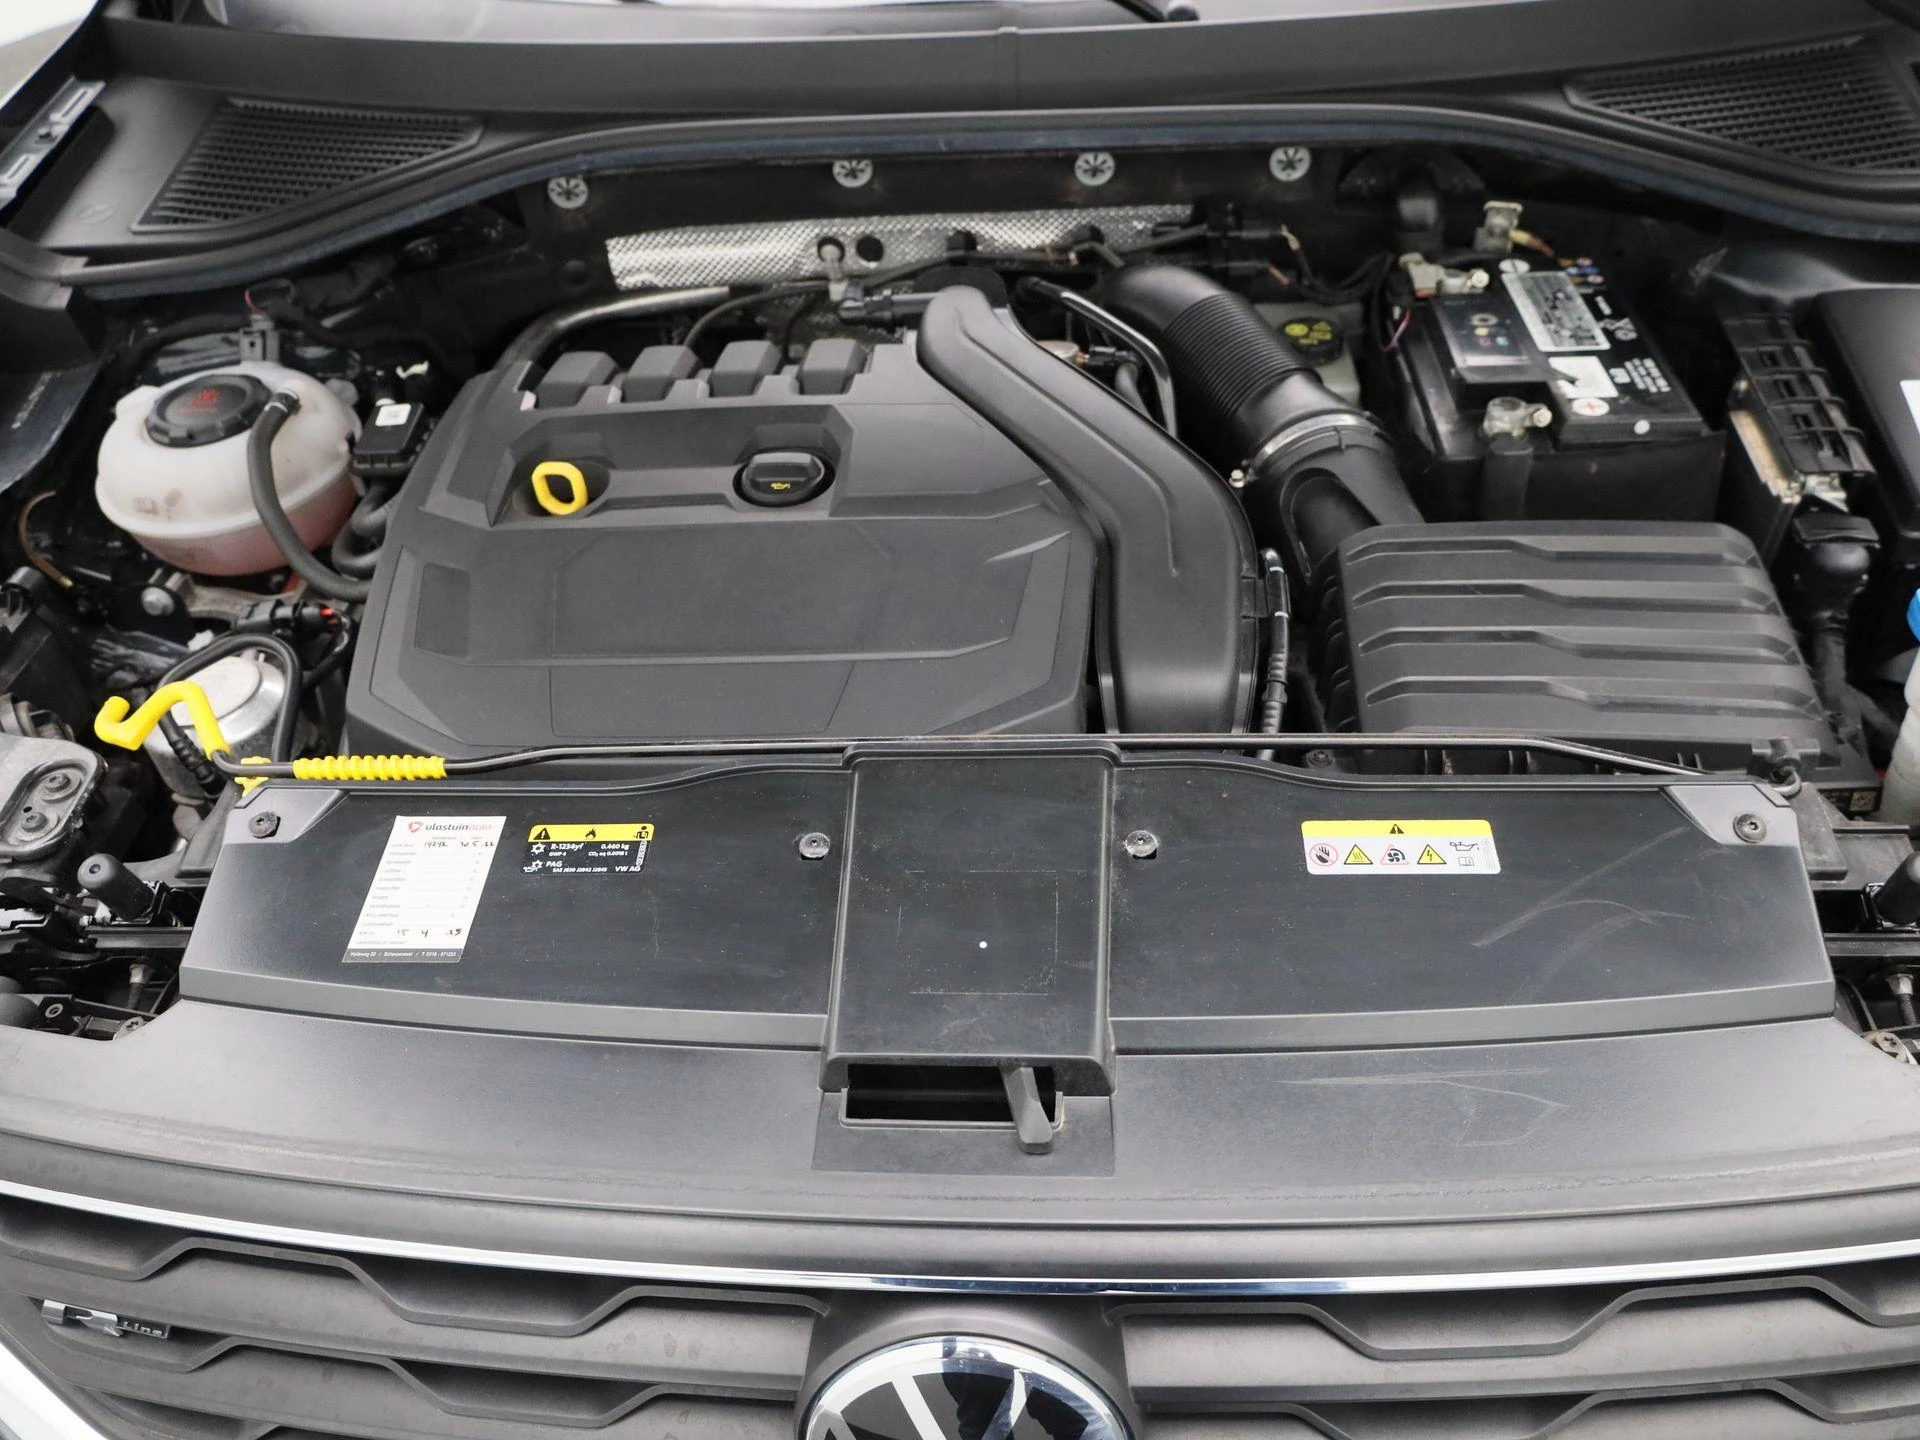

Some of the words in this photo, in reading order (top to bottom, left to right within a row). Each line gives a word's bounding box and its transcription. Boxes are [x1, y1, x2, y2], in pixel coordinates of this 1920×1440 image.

[551, 842, 584, 851] R-1234yf
[621, 843, 630, 851] kg
[546, 860, 563, 868] PAG
